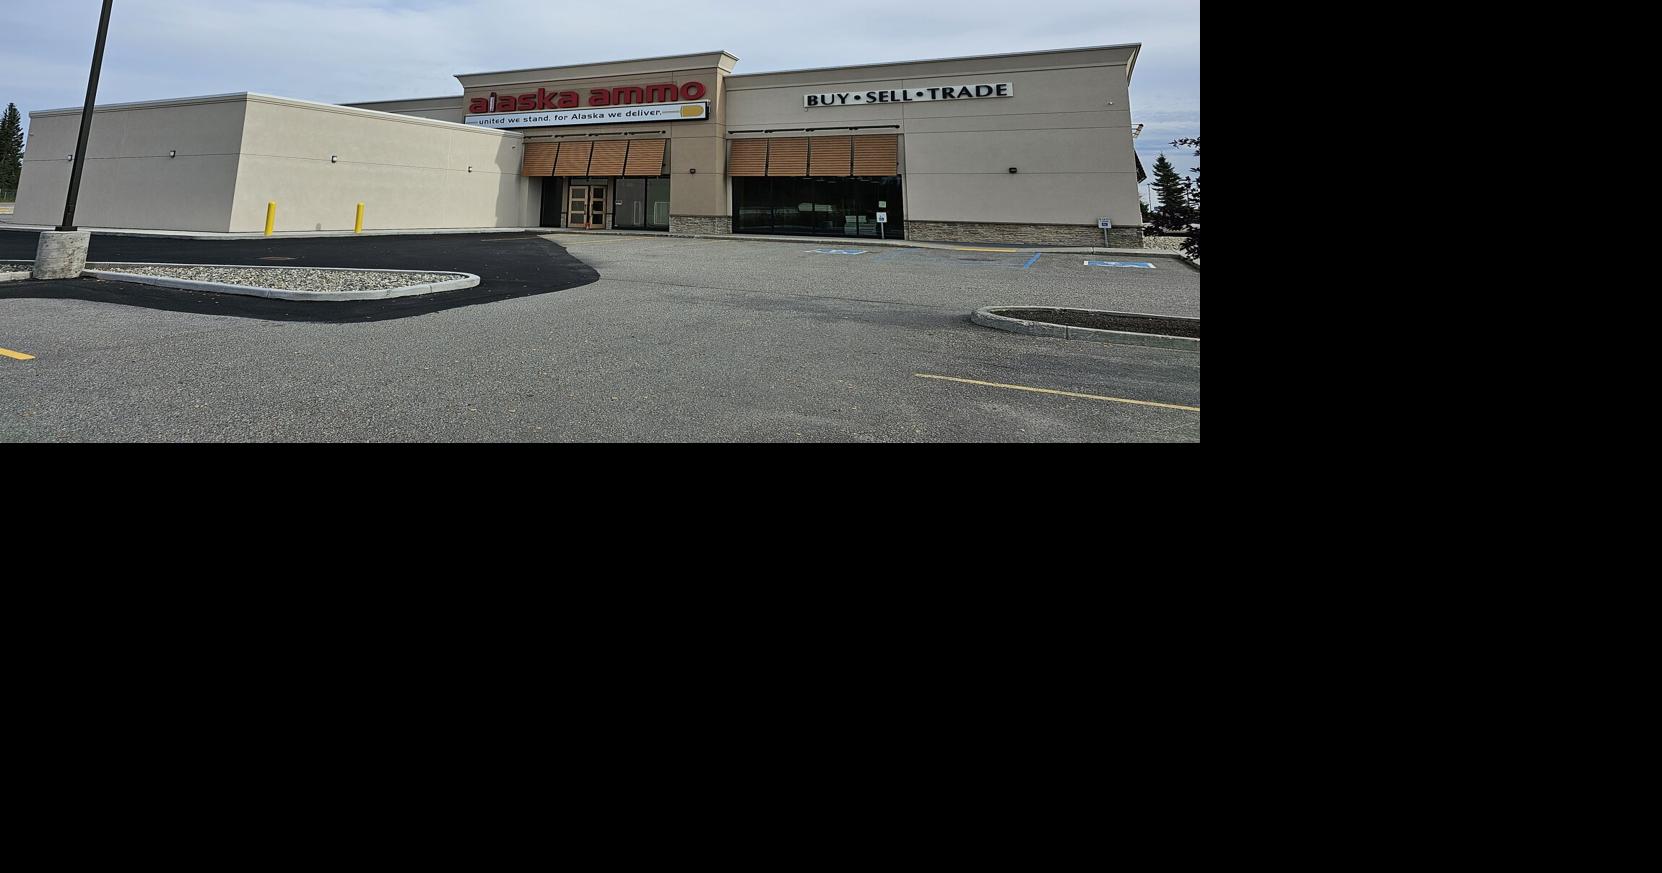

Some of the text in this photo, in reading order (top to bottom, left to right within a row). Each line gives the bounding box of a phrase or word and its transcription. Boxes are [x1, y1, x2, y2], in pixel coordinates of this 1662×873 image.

[469, 81, 707, 114] alaska ammo
[807, 83, 1008, 106] BUY SELL TRADE
[478, 117, 505, 125] united
[571, 112, 605, 121] Alaska
[625, 109, 662, 117] deliver.
